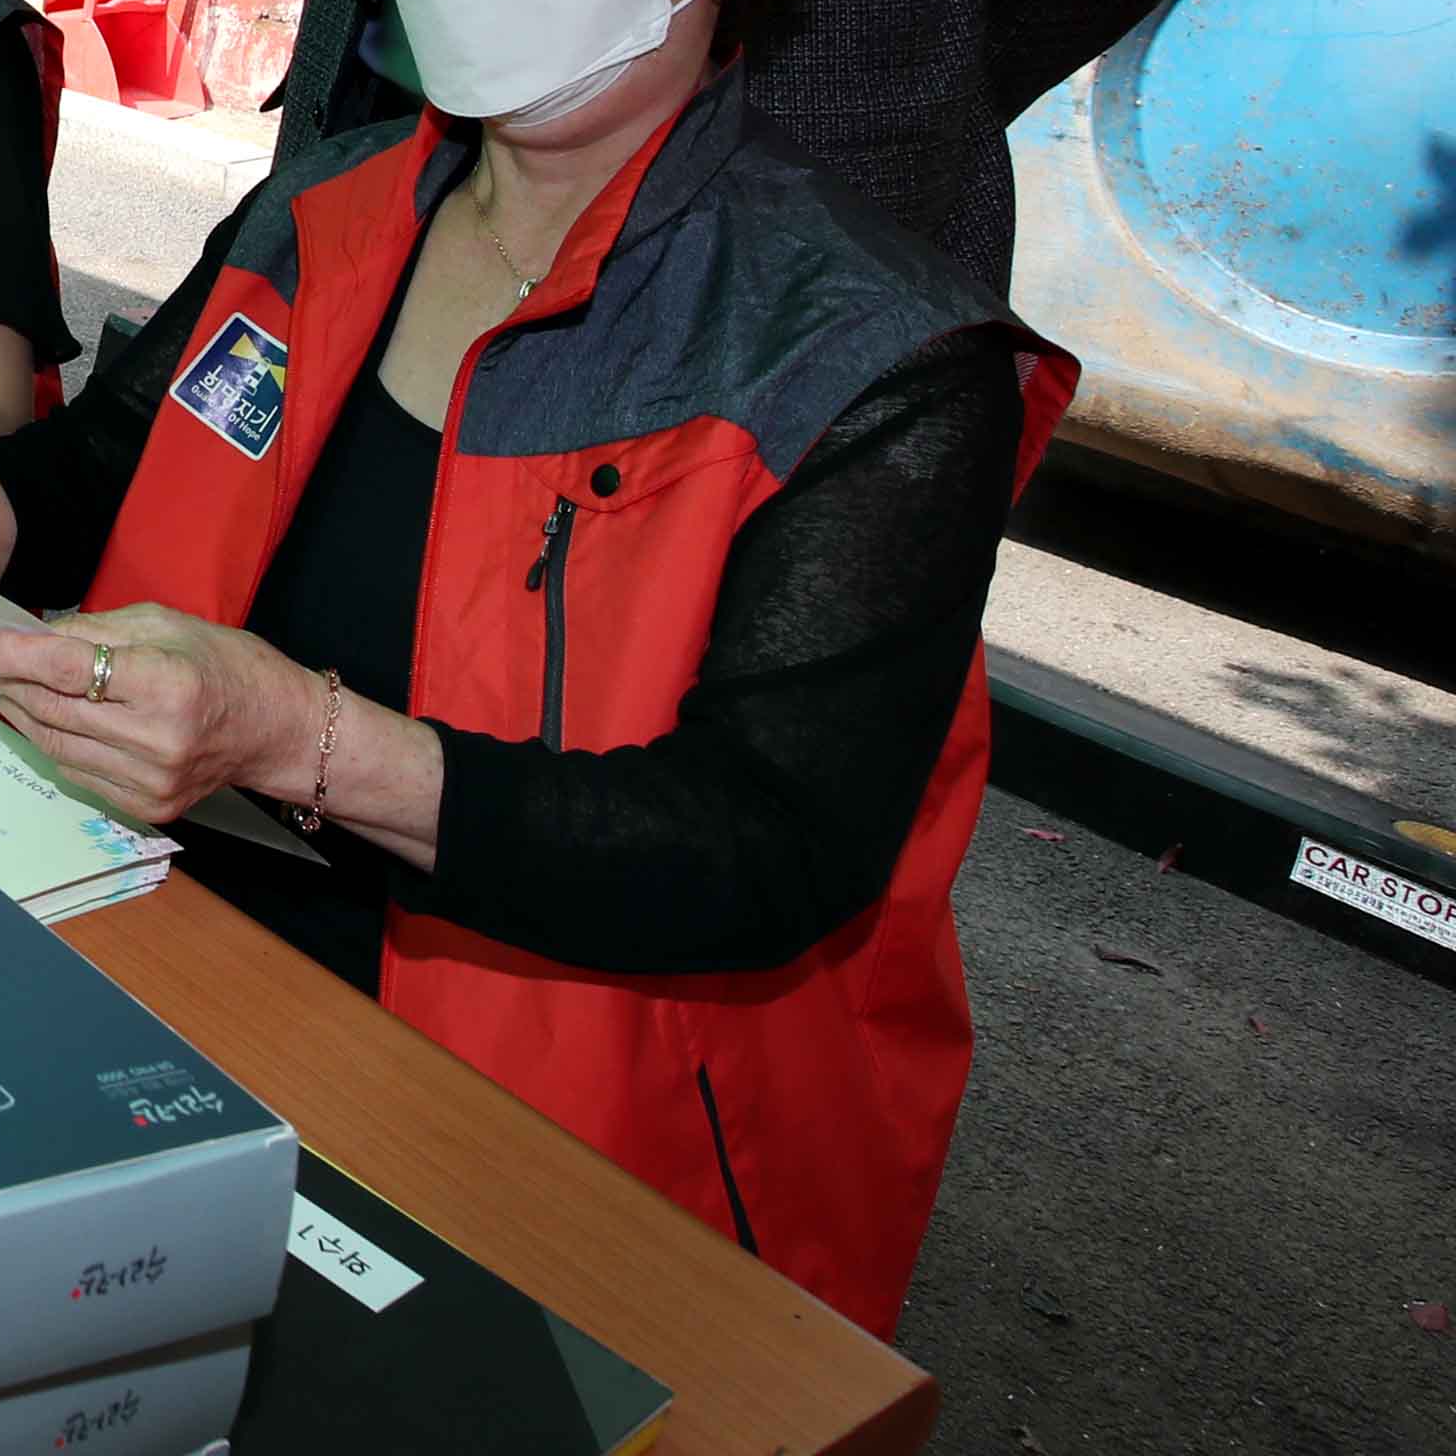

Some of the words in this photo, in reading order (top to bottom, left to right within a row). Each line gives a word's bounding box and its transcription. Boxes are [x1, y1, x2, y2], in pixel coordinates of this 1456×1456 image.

[199, 364, 278, 433] 희망지기
[239, 418, 262, 442] Hope
[1304, 845, 1371, 887] CAR
